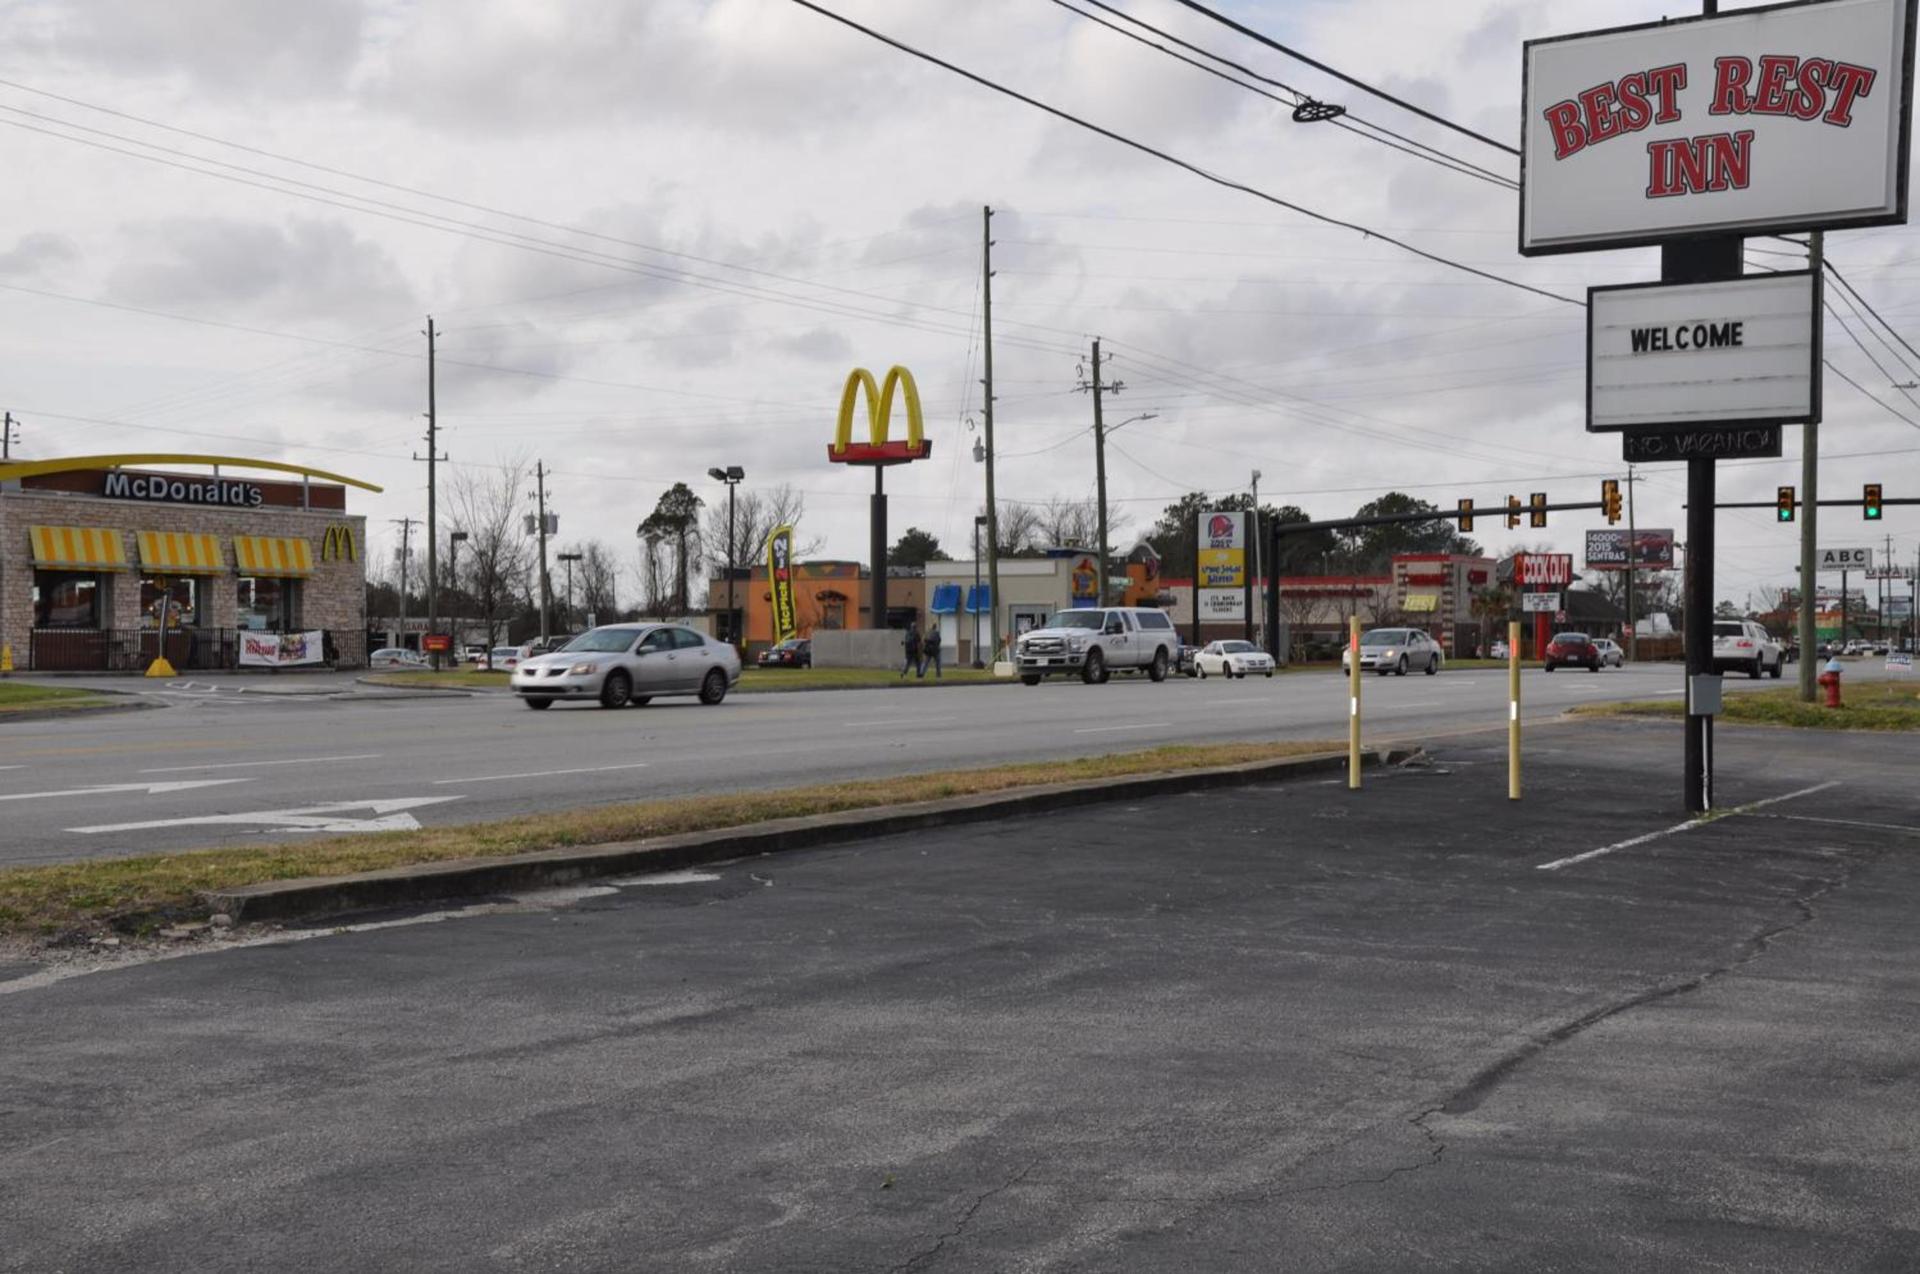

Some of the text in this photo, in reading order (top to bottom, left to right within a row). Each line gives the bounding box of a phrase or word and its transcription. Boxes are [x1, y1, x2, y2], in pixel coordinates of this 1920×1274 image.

[1544, 55, 1876, 160] BEST REST
[1646, 130, 1754, 199] INN
[1631, 322, 1743, 352] WELCOME
[1674, 430, 1770, 453] VACANCY
[104, 473, 263, 504] McDonald's
[1587, 551, 1626, 561] SENTRAS
[1588, 543, 1612, 552] 2015
[1523, 554, 1569, 584] COOK OUT
